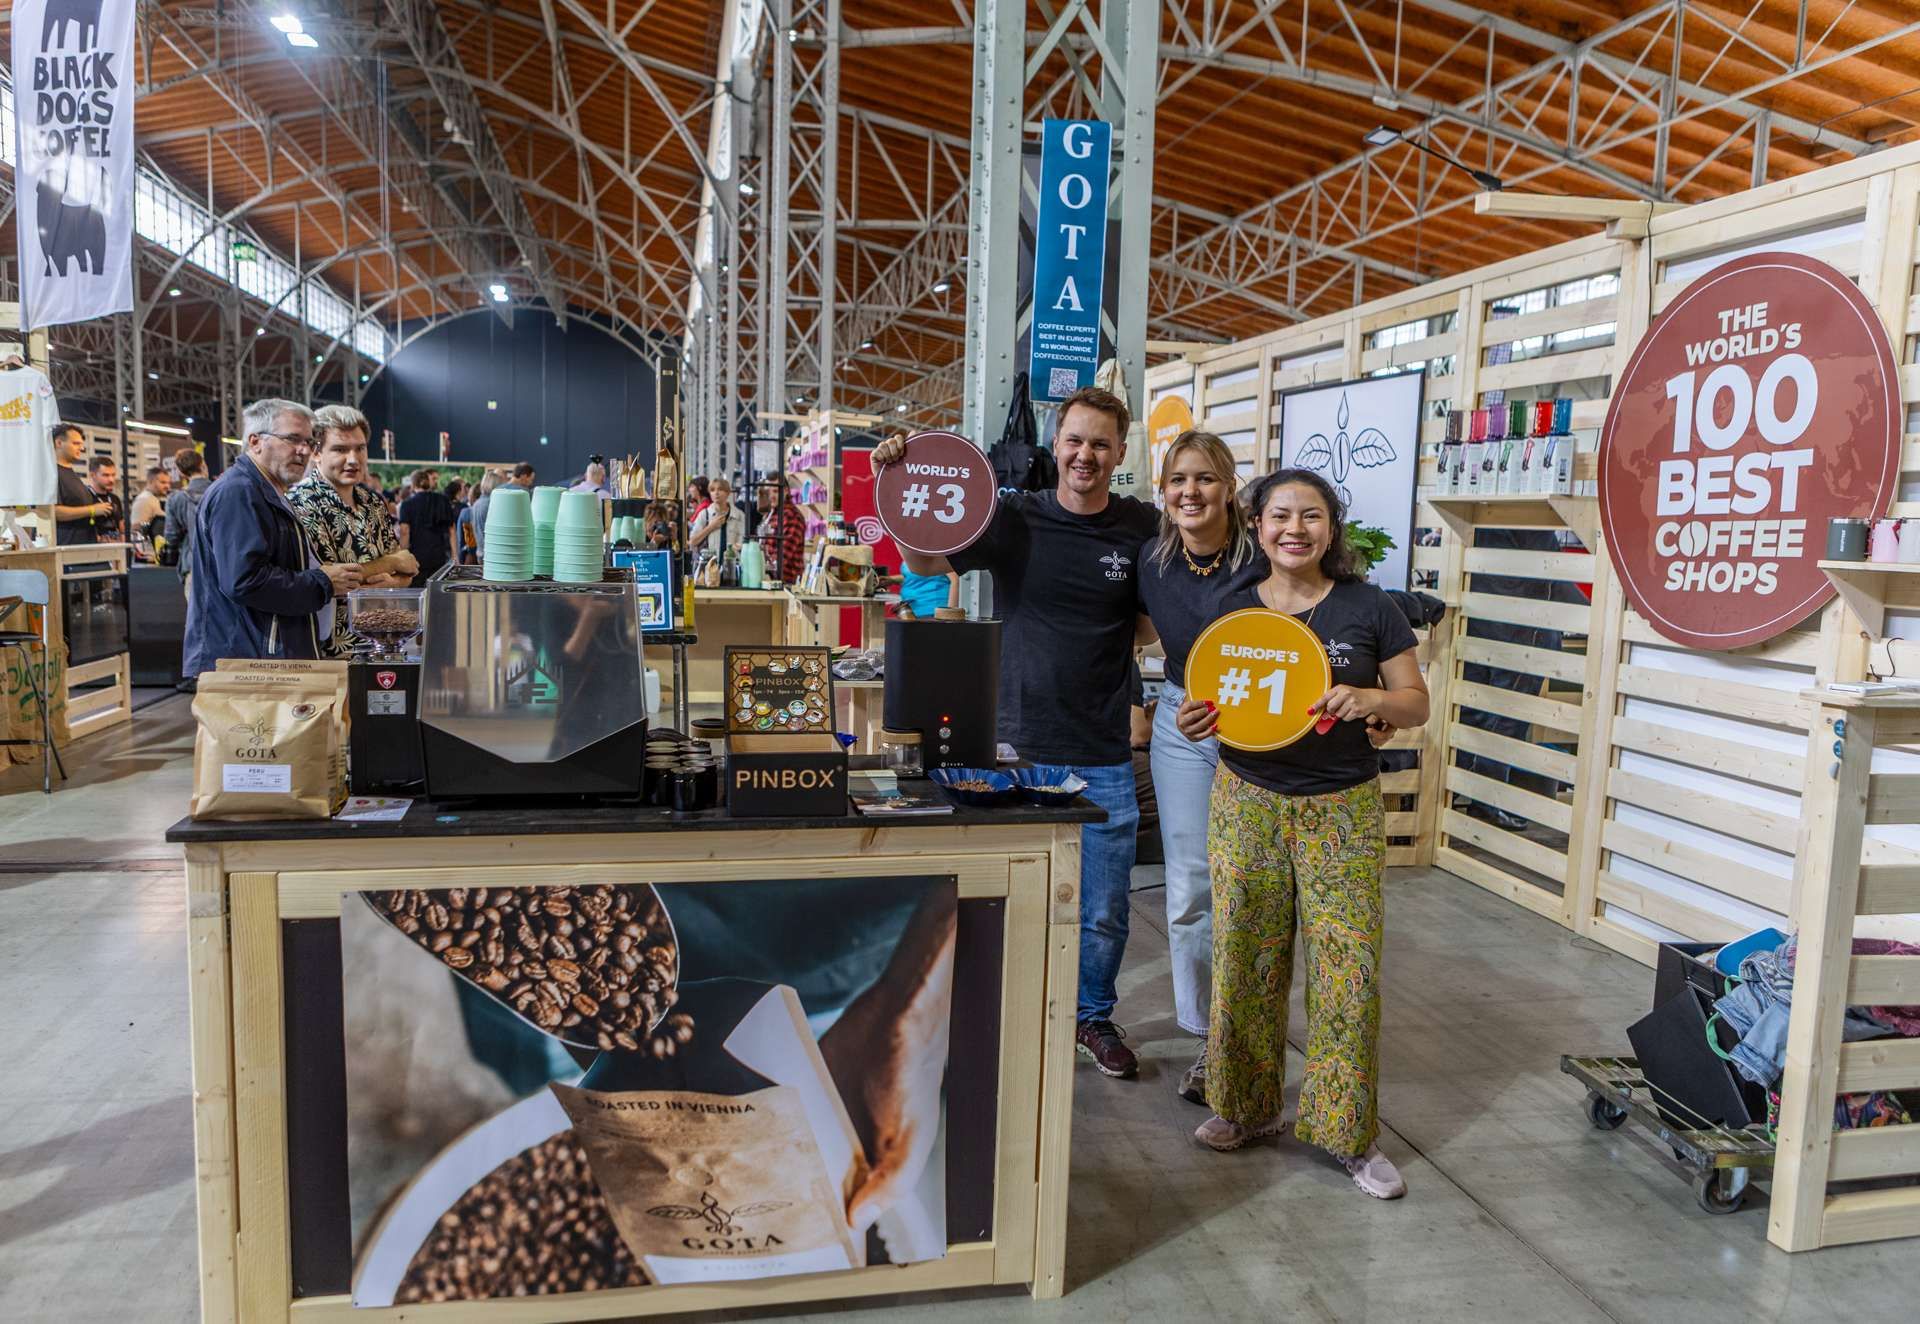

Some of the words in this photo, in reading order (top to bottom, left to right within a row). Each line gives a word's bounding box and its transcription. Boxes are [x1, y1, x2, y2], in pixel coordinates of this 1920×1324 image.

[33, 52, 118, 90] BLACK
[36, 90, 114, 126] DOGS
[1052, 123, 1094, 312] GOTA
[1038, 322, 1065, 331] COFFEE
[1065, 326, 1096, 334] EXPERTS
[1718, 302, 1768, 334] THE
[1039, 333, 1057, 341] BEST
[1066, 336, 1094, 344] EUROPE
[1050, 344, 1092, 353] WORLDWIDE
[1685, 323, 1802, 367] WORLD'S
[1666, 353, 1818, 453] 100
[905, 463, 970, 479] WORLD'S
[1656, 448, 1814, 516] BEST
[901, 483, 966, 524] #3
[1655, 519, 1807, 558] COFFEE
[1105, 570, 1127, 579] GOTA
[1664, 560, 1780, 596] SHOPS
[1220, 643, 1300, 664] EUROPE'S
[1328, 656, 1350, 665] OTA
[1217, 667, 1287, 715] #1
[235, 748, 276, 759] GOTA
[665, 1100, 683, 1111] IN
[687, 1102, 756, 1115] VIENNA
[681, 1234, 784, 1250] GOTA
